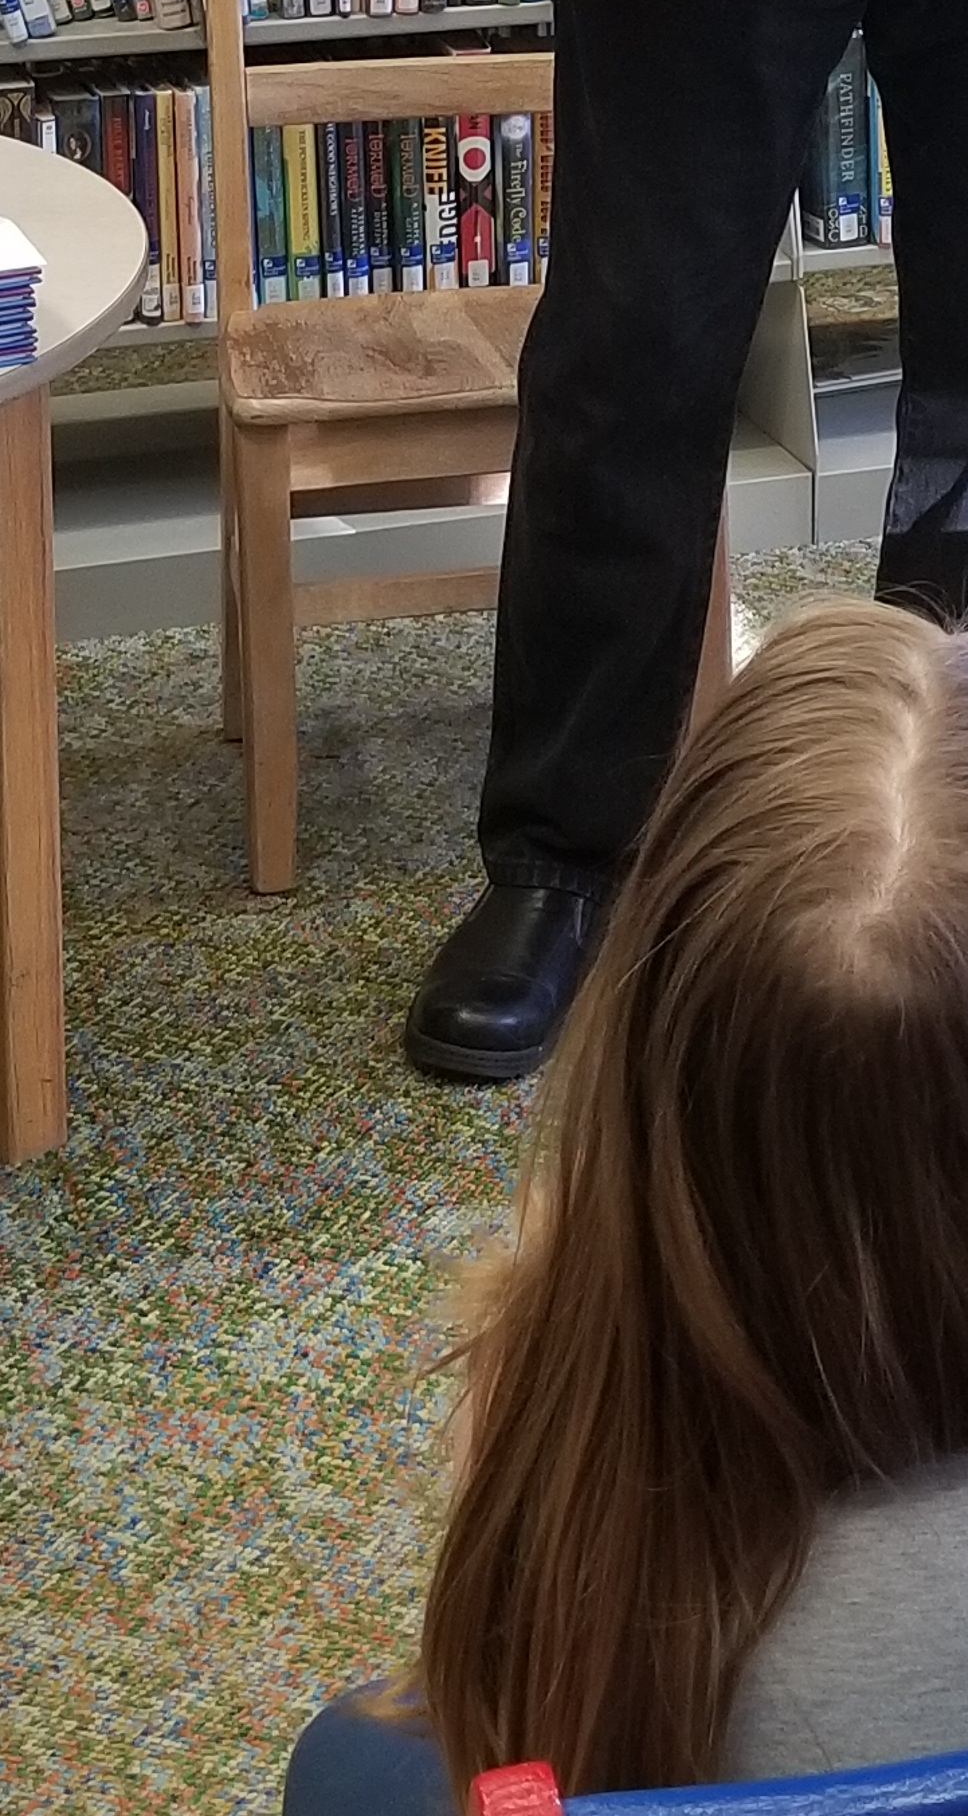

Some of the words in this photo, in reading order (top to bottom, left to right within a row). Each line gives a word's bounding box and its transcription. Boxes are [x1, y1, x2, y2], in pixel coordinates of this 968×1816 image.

[839, 73, 854, 181] PATHFINDER
[423, 127, 447, 195] KNIFE
[506, 160, 527, 204] Firefly
[510, 207, 527, 243] Code
